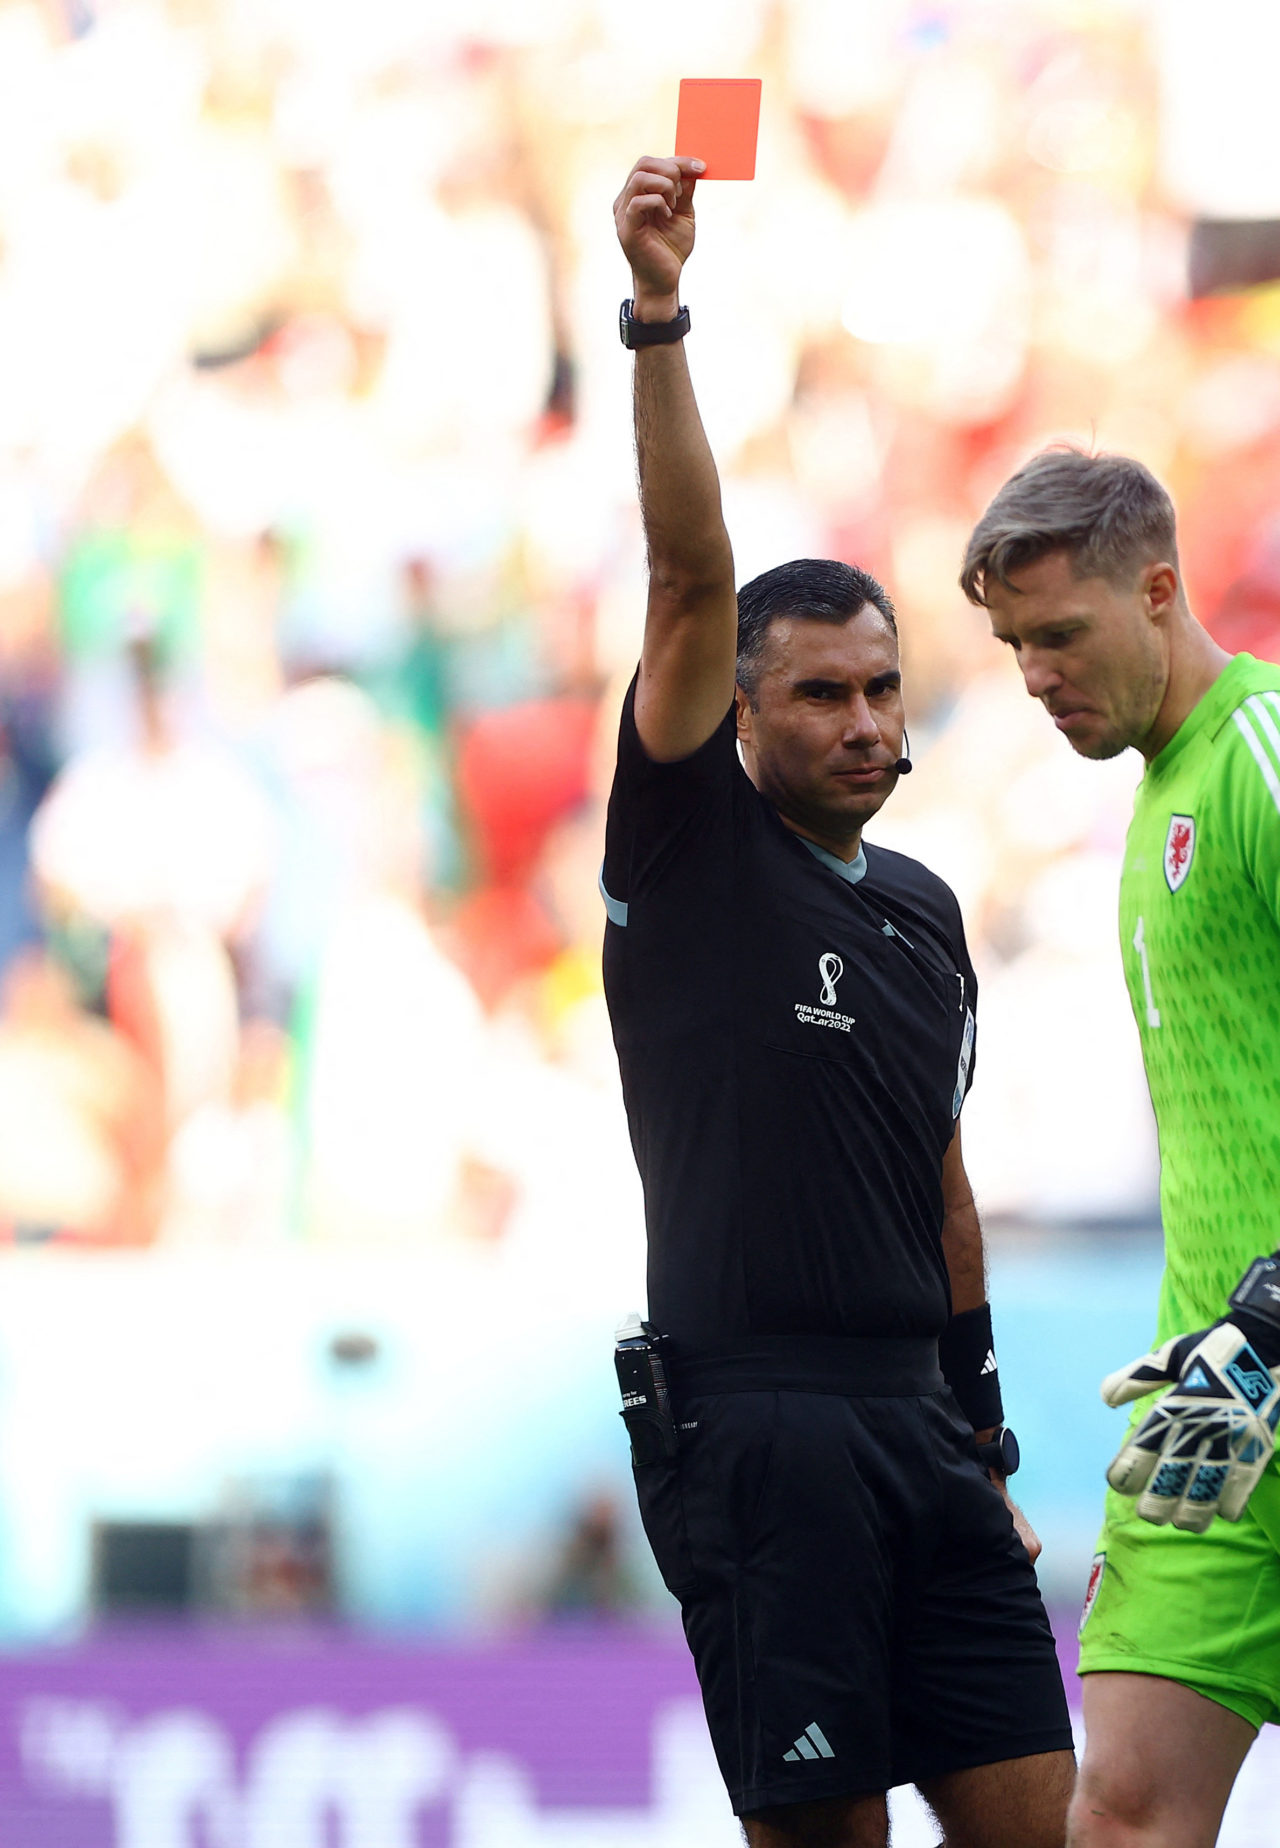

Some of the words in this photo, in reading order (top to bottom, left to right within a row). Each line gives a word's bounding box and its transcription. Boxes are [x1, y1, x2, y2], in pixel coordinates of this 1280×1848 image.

[1133, 916, 1161, 1028] 1
[794, 1003, 813, 1014] FIFA
[813, 1008, 842, 1020] WORLD
[841, 1015, 856, 1025] CUP
